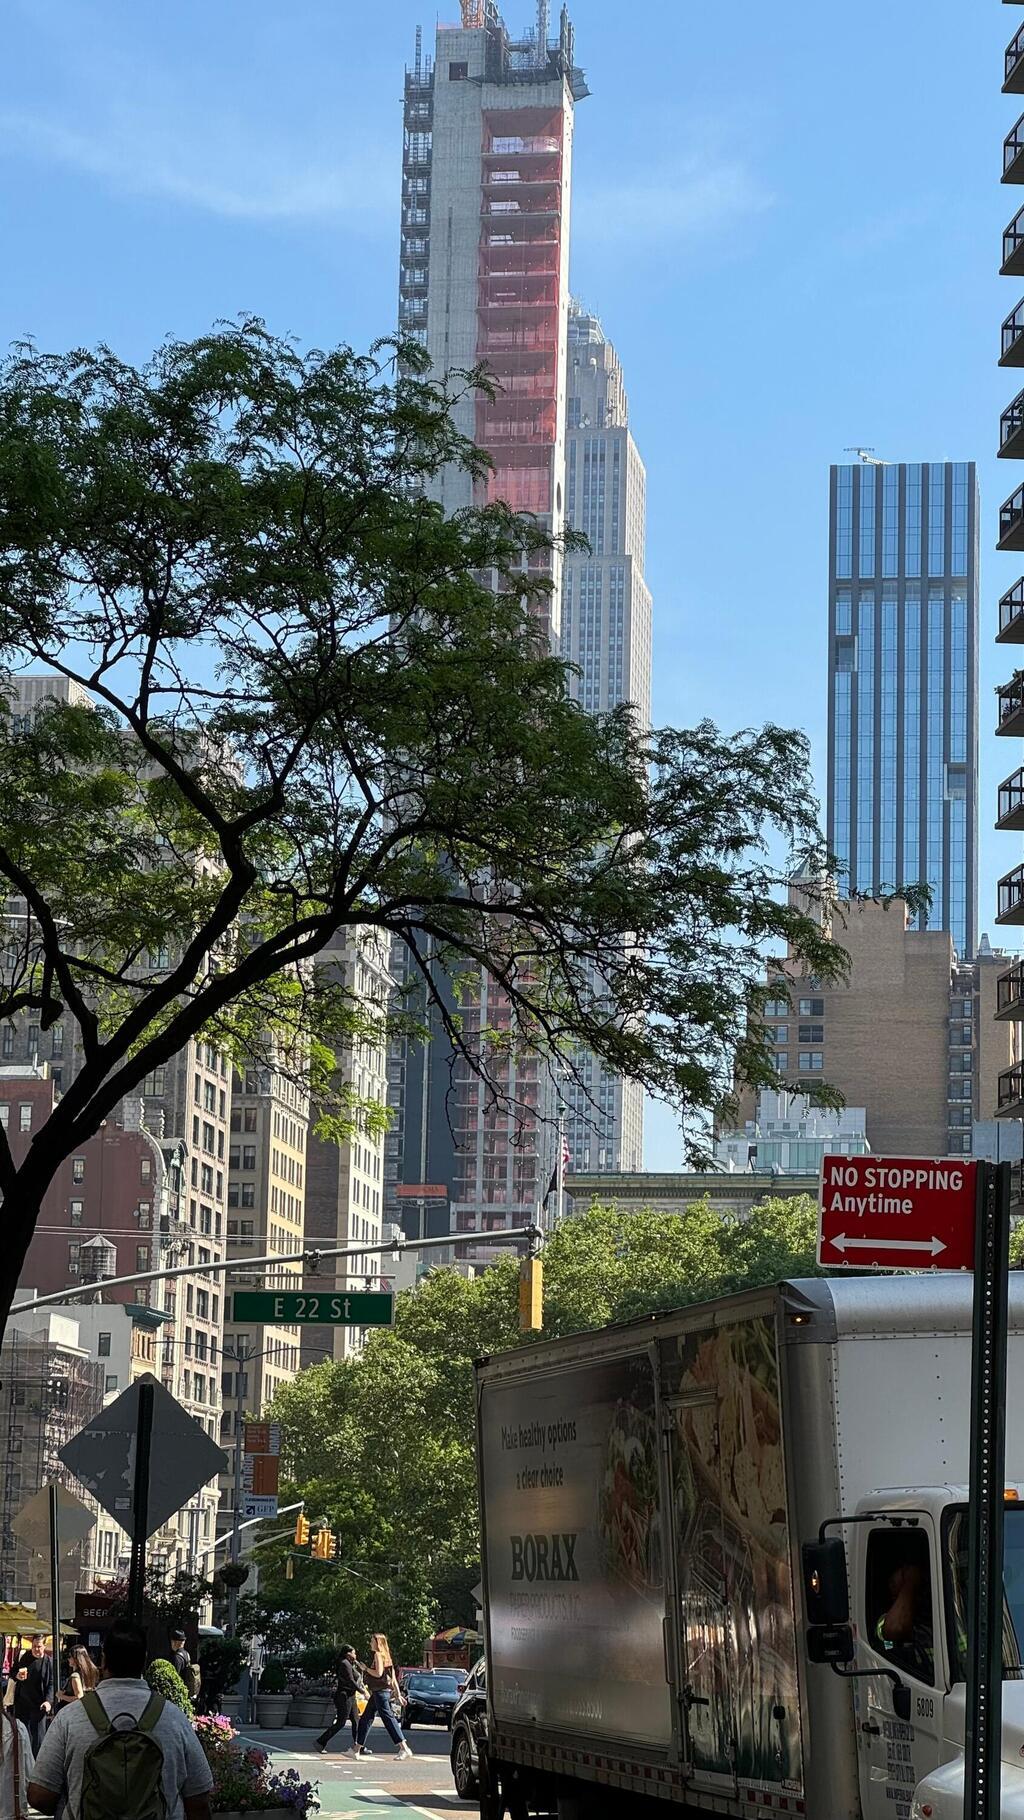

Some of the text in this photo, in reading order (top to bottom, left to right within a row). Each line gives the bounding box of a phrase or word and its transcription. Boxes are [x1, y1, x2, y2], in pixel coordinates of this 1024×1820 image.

[831, 1166, 963, 1191] NO STOPPING
[830, 1192, 913, 1217] Anytime
[274, 1298, 351, 1319] E 22 St
[501, 1417, 577, 1453] Make healthy options
[516, 1462, 564, 1490] a clear choice
[510, 1533, 580, 1583] BORAX
[83, 1608, 108, 1617] BEER
[916, 1697, 934, 1719] 5809
